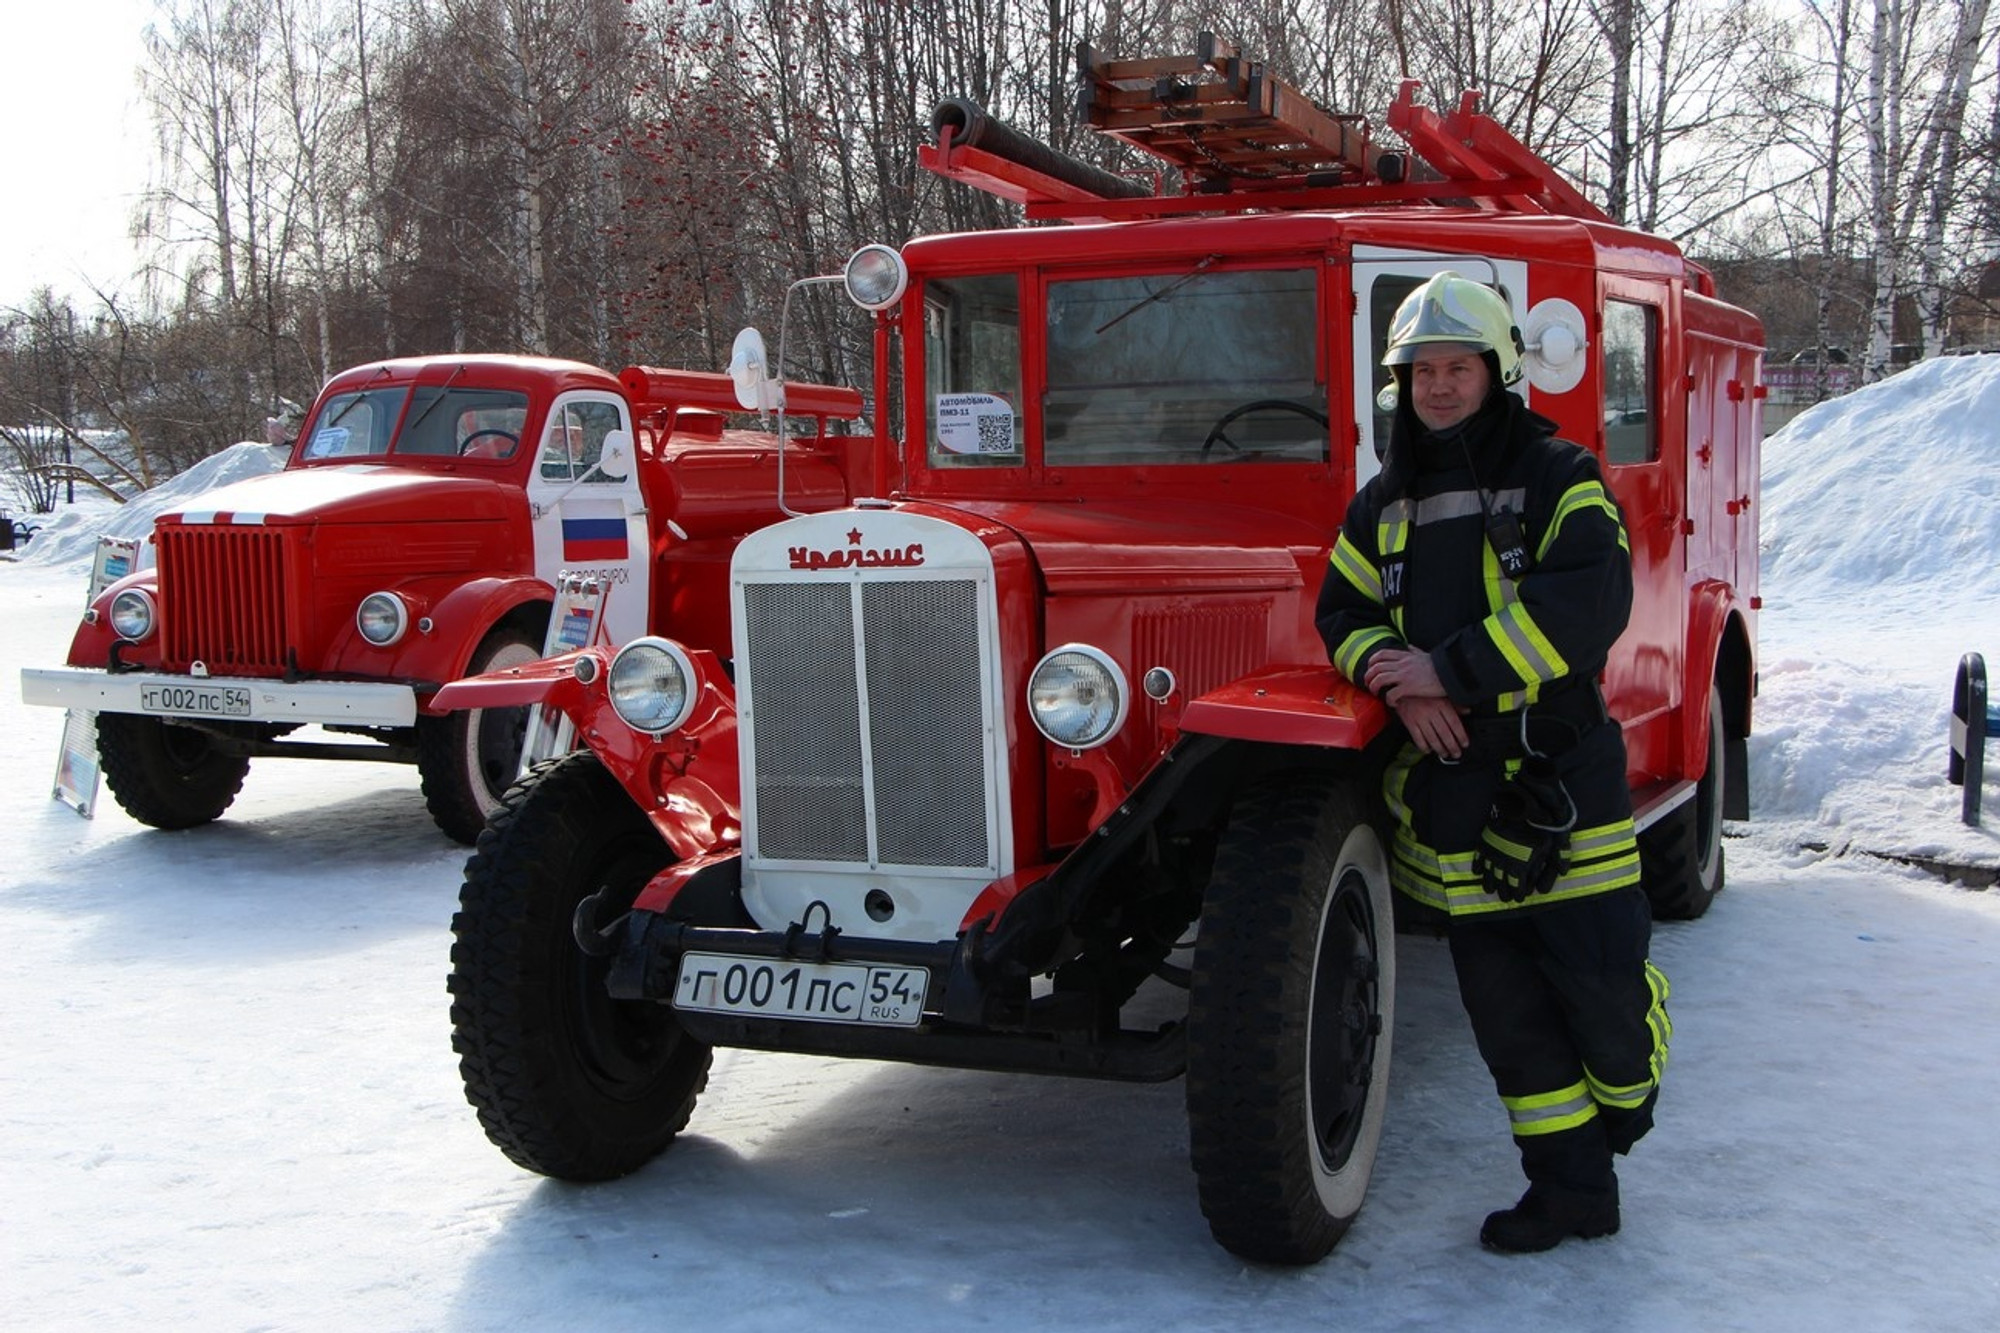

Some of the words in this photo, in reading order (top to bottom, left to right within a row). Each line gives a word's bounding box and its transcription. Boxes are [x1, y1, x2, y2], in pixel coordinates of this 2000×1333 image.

[940, 396, 993, 407] АВТОМОБИЛЬ
[940, 408, 969, 416] ПМЗ-11
[1381, 562, 1404, 598] 247
[225, 690, 244, 707] 54
[870, 971, 910, 1005] 54
[870, 1007, 900, 1020] RUS
